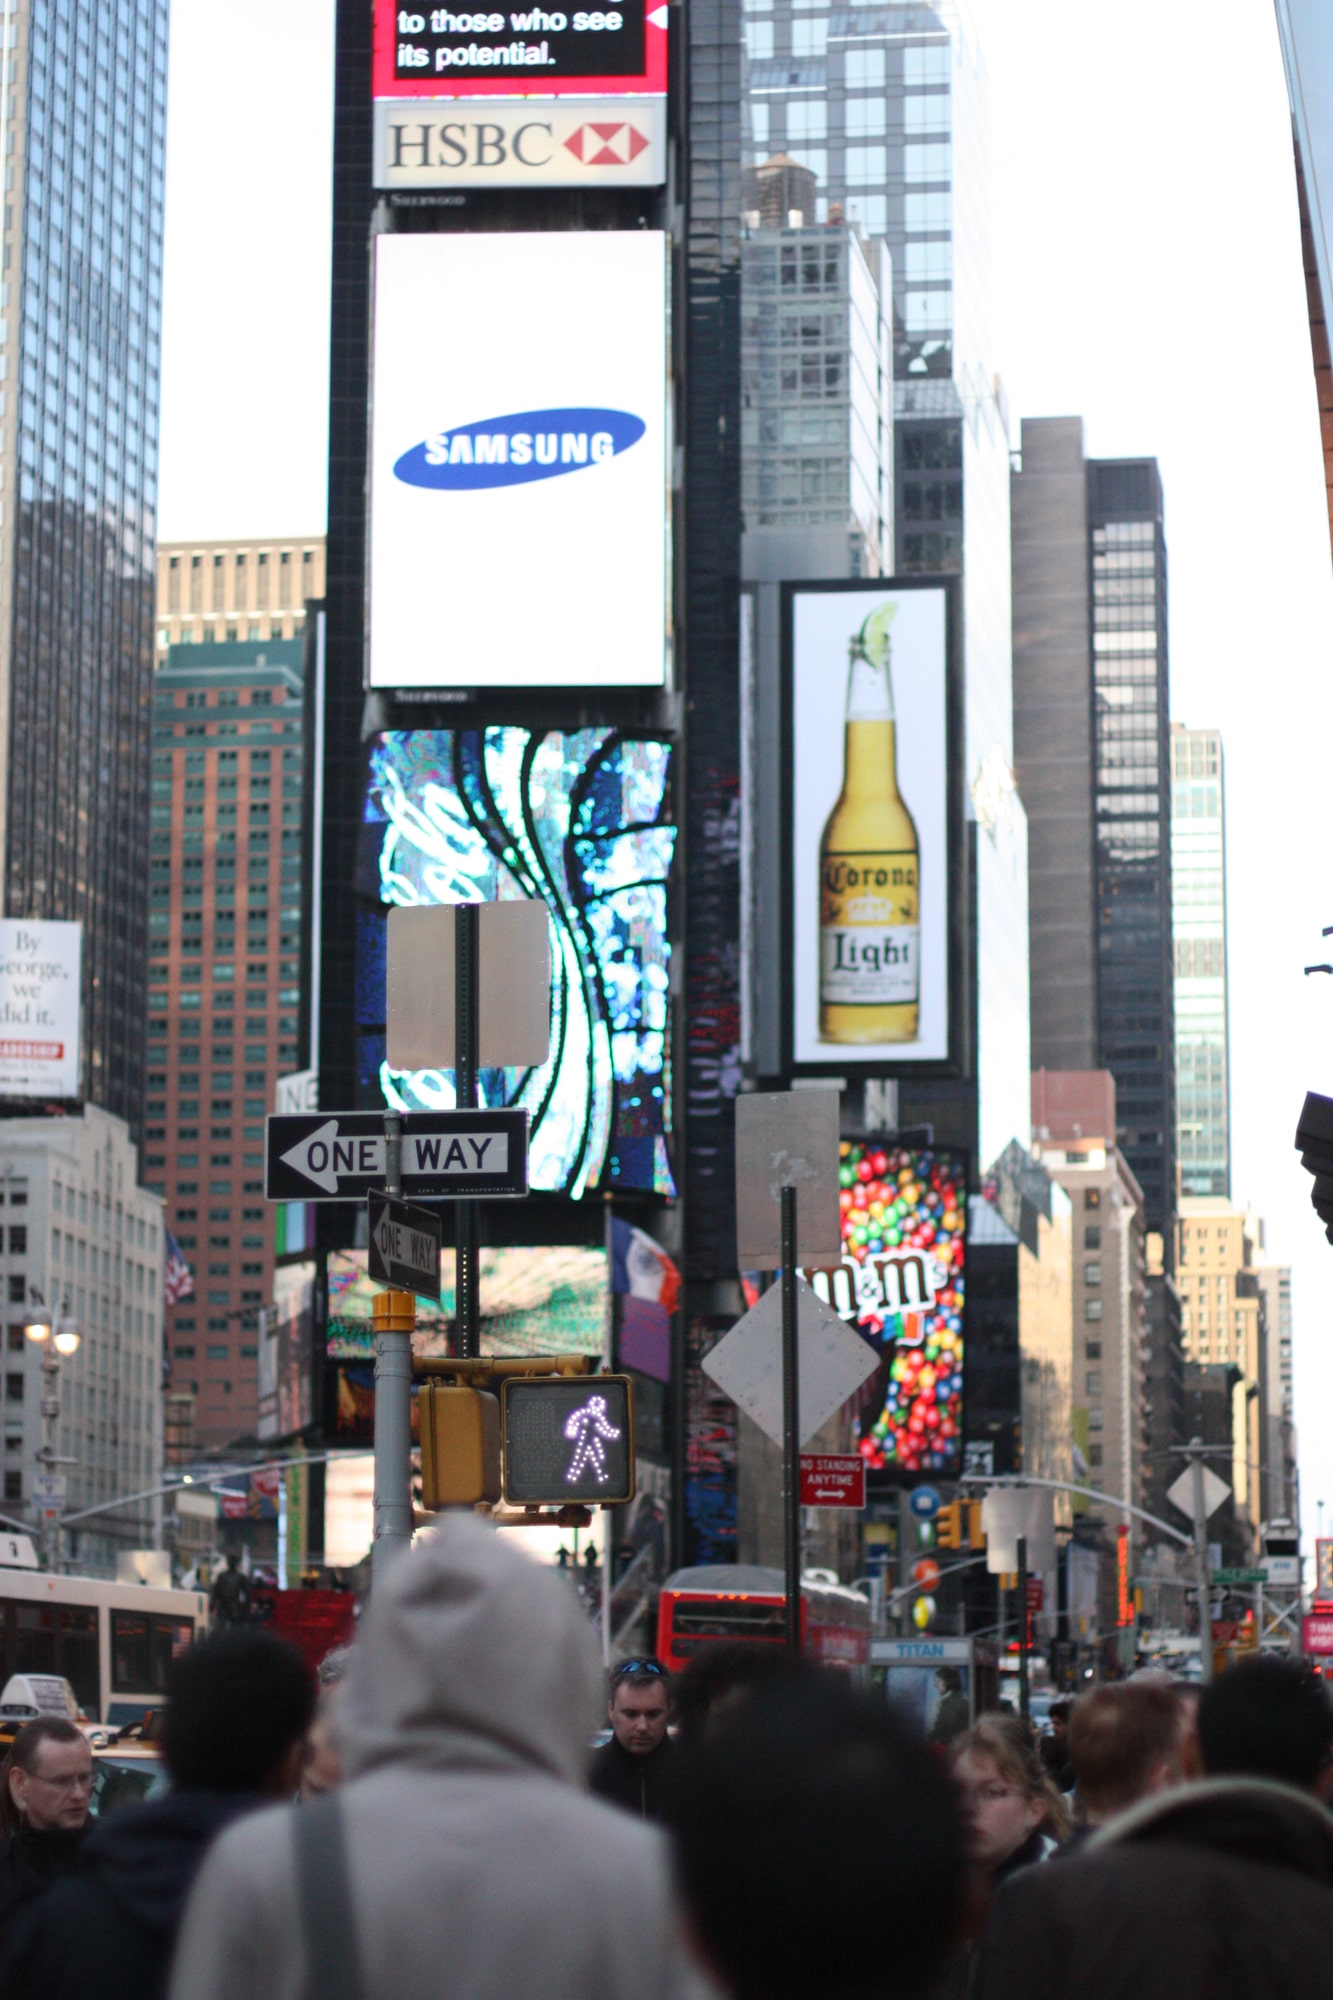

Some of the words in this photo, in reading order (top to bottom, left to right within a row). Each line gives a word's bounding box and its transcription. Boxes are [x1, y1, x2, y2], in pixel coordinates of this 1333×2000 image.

[398, 10, 425, 34] to
[431, 9, 505, 33] those
[511, 8, 568, 32] who
[573, 10, 624, 31] see
[397, 43, 430, 67] its
[435, 41, 556, 72] potential.
[387, 122, 553, 168] HSBC
[424, 432, 615, 465] SAMSUNG
[16, 932, 41, 956] By
[833, 932, 910, 973] Light
[13, 983, 42, 999] we
[307, 1139, 378, 1173] ONE
[414, 1137, 493, 1171] WAY
[380, 1221, 402, 1260] ONE
[411, 1231, 433, 1269] WAY
[807, 1473, 855, 1486] ANYTIME
[816, 1459, 861, 1472] STANDING
[896, 1643, 944, 1658] TITAN
